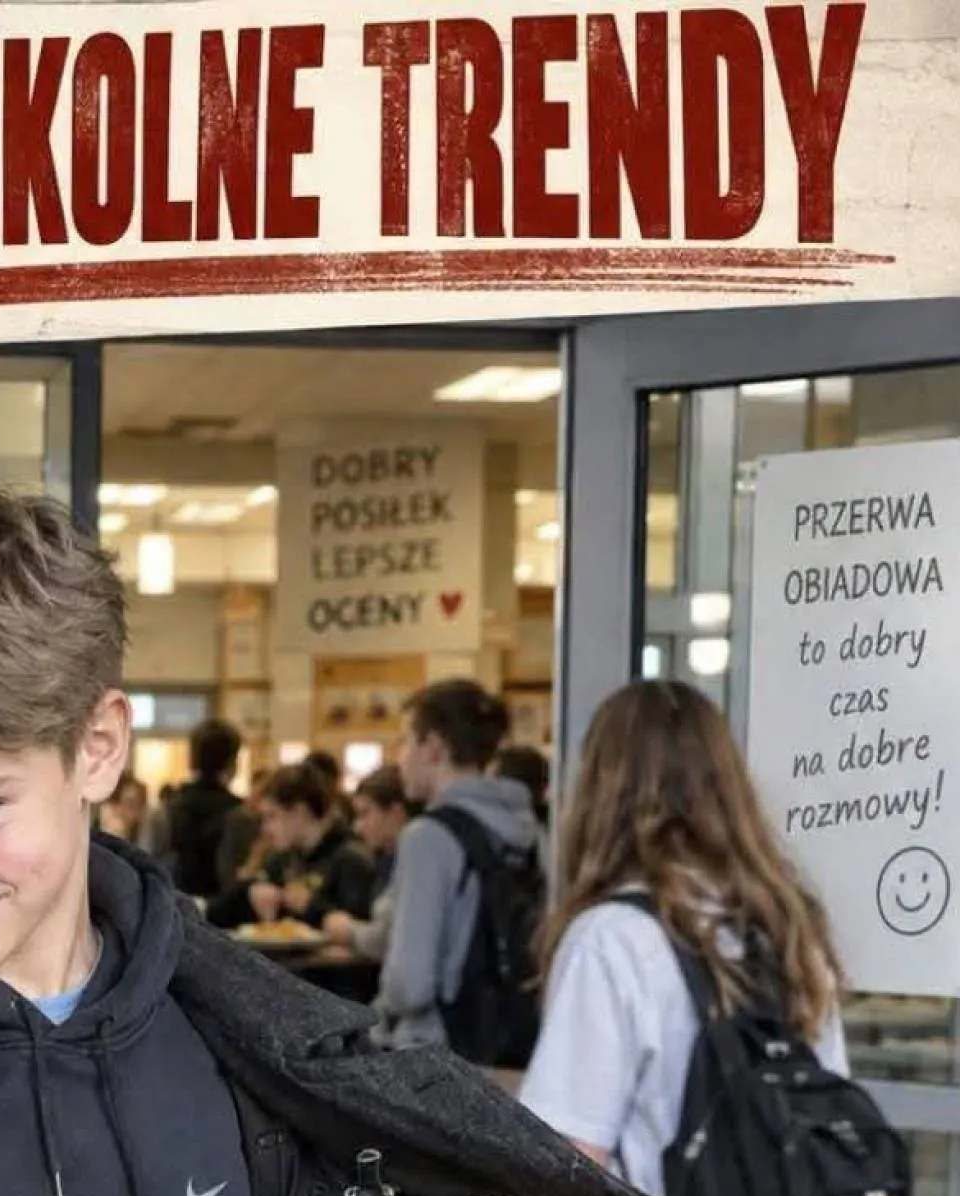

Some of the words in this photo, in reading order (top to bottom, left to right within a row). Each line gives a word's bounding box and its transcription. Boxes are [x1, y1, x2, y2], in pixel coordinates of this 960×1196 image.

[311, 446, 442, 488] DOBRY
[793, 491, 936, 542] PRZERWA
[311, 539, 442, 580] LEPSZE
[783, 557, 944, 606] OBIADOWA
[308, 592, 426, 634] OCENY
[799, 631, 826, 666] to
[839, 618, 927, 669] dobry
[829, 687, 889, 717] czas
[792, 751, 825, 779] na
[838, 728, 930, 771] dobre
[785, 769, 945, 833] rozmowy!
